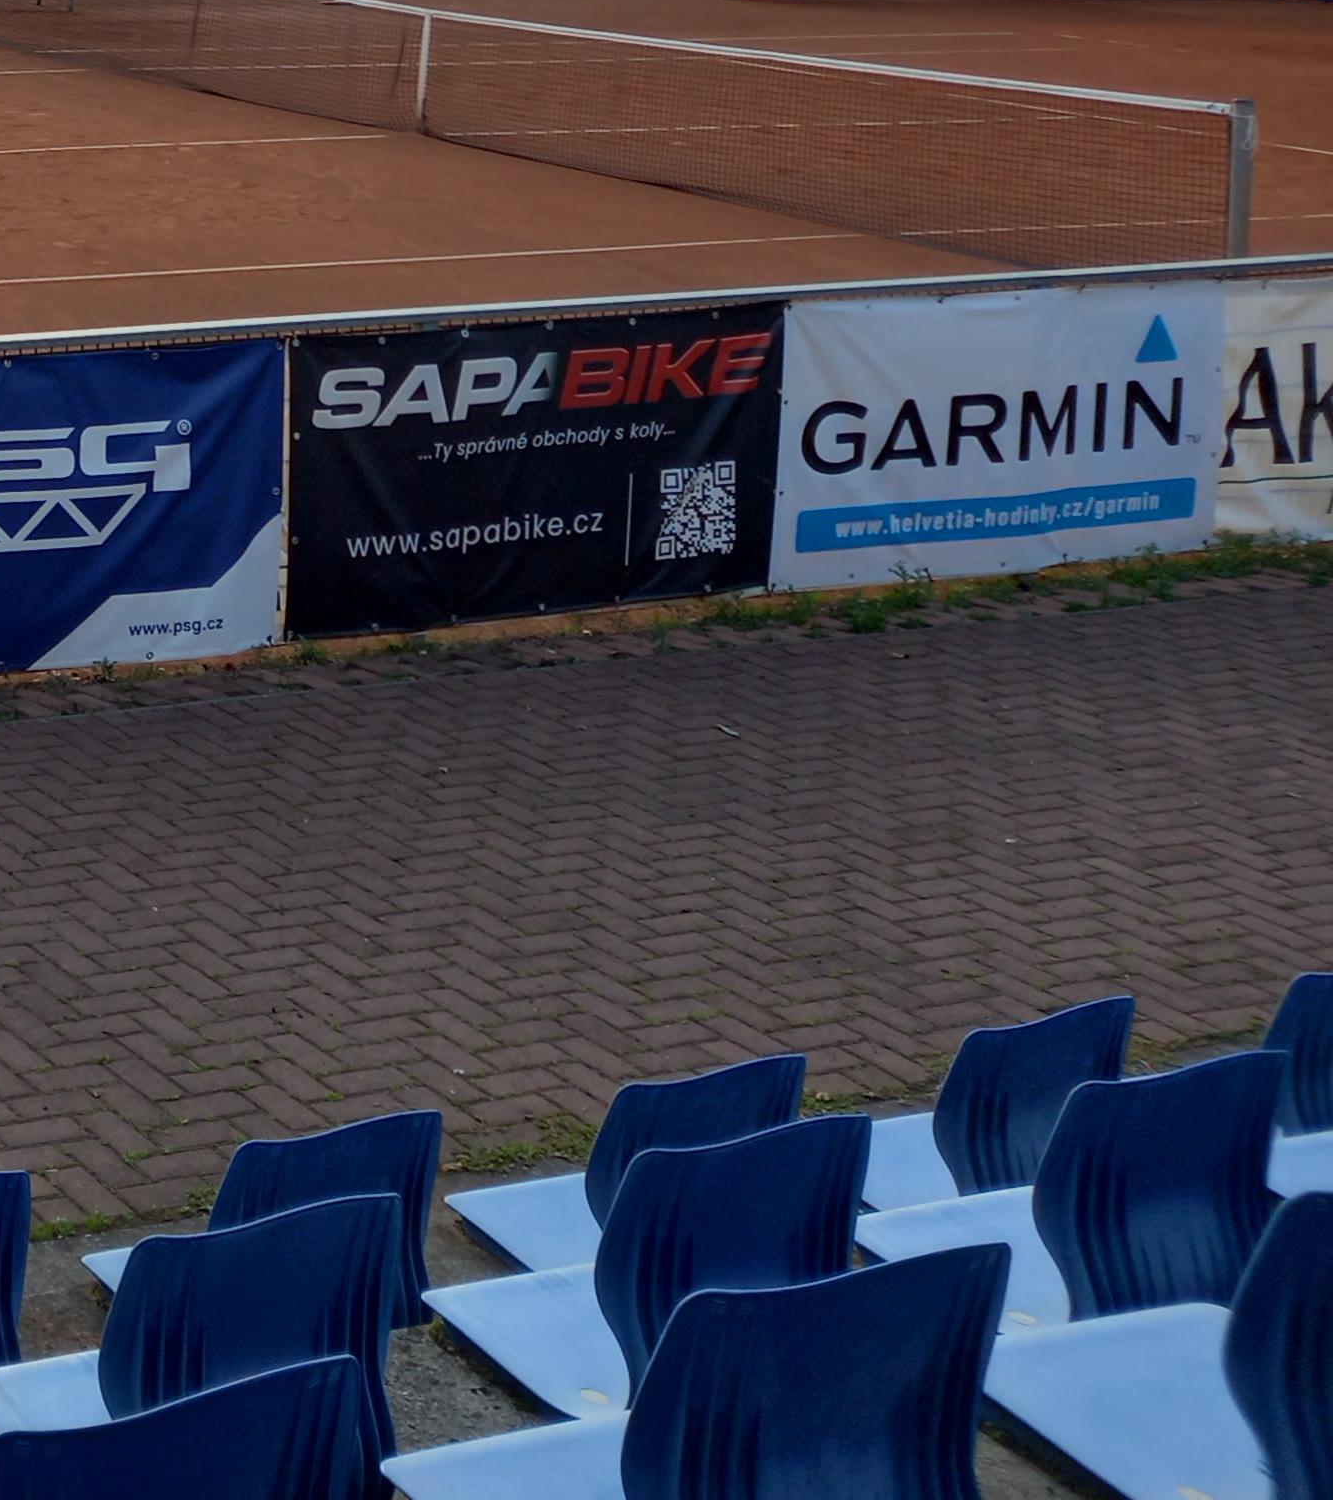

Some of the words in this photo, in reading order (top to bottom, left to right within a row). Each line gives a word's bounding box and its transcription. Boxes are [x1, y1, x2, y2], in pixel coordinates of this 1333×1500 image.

[312, 333, 773, 430] SAPABIKE
[456, 433, 528, 458] správné
[533, 425, 611, 449] obchody
[615, 426, 625, 441] s
[800, 377, 1184, 475] GARMIN
[347, 510, 604, 559] www.sapabike.cz
[834, 491, 1161, 538] www.helvetia-hodinky.cz/garmin
[129, 616, 224, 637] www.psg.cz
